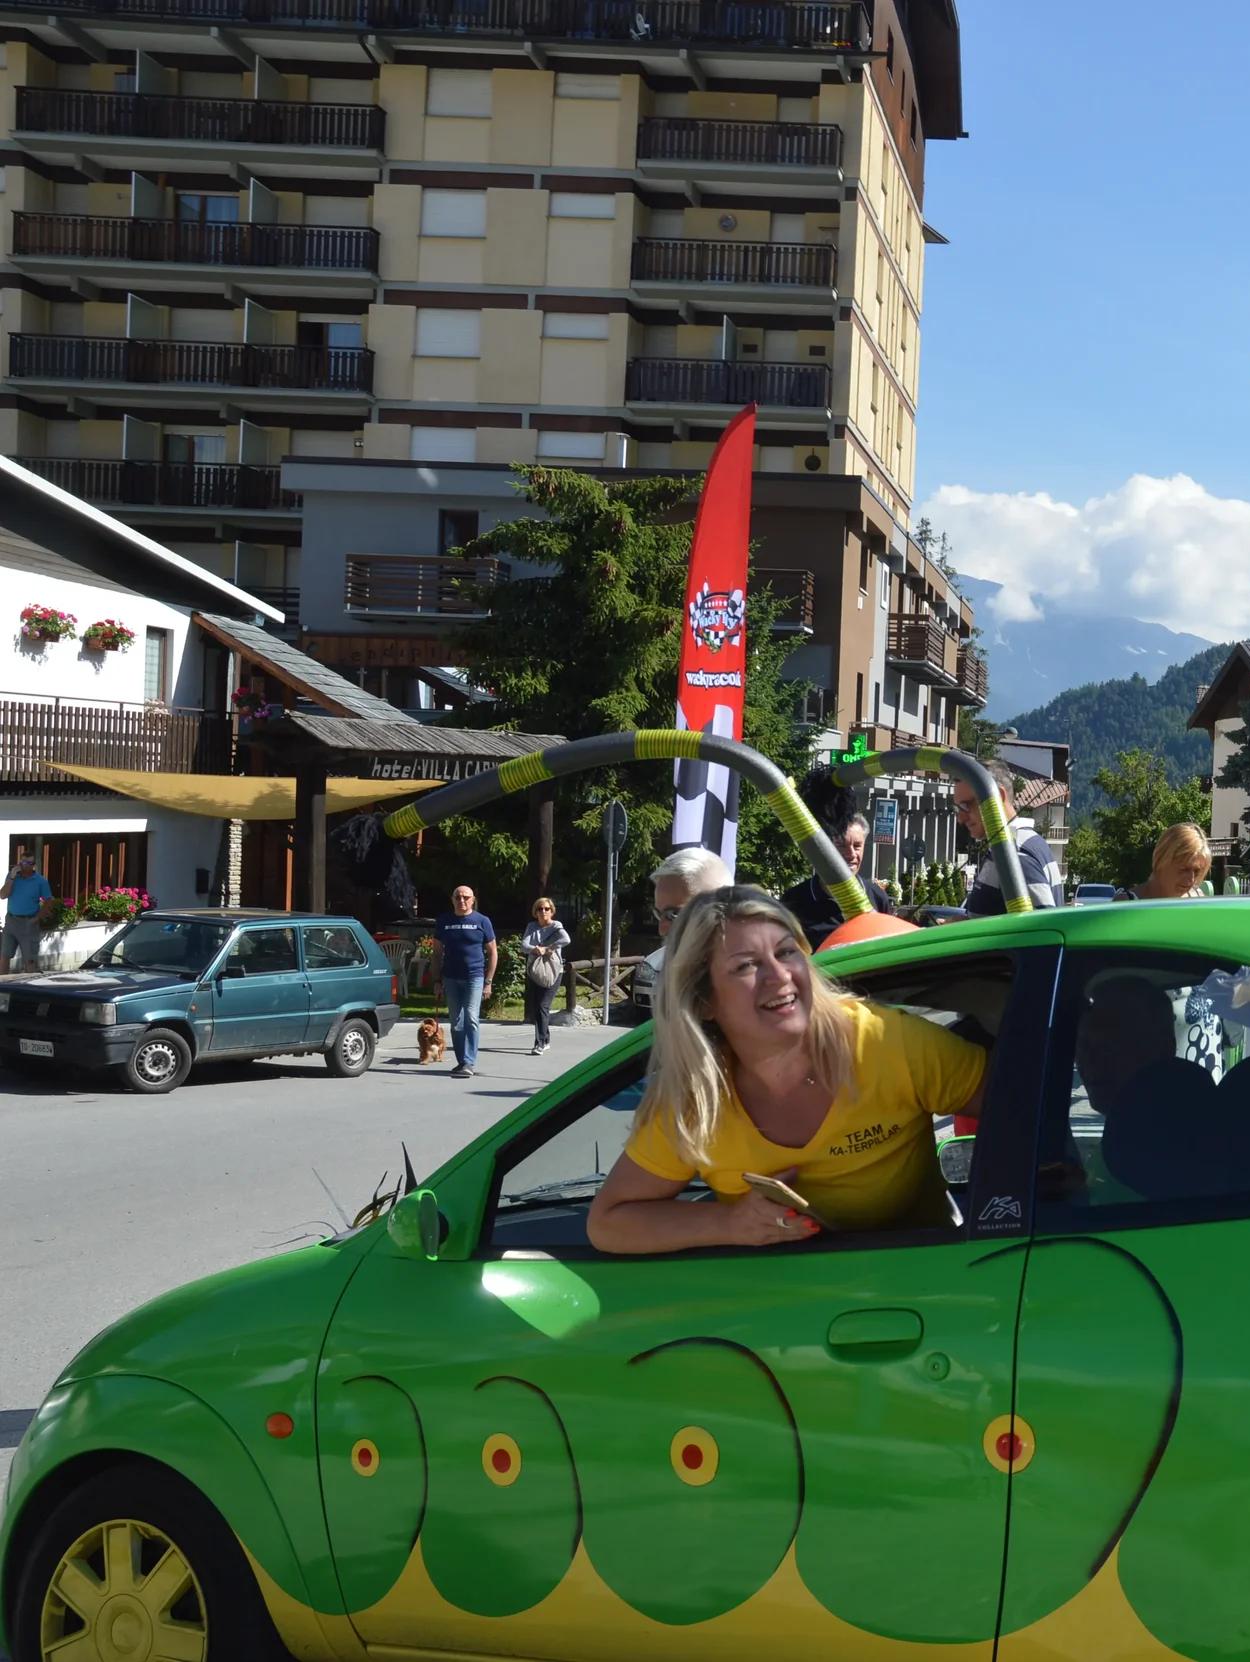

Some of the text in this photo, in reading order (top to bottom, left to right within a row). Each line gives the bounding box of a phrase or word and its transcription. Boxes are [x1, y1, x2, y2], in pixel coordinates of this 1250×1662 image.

[371, 756, 418, 778] hotel
[421, 758, 460, 781] VILLA
[829, 1125, 901, 1156] KA-TERPILLAR
[844, 1124, 884, 1144] TEAM
[977, 1222, 1022, 1231] COLLECTION
